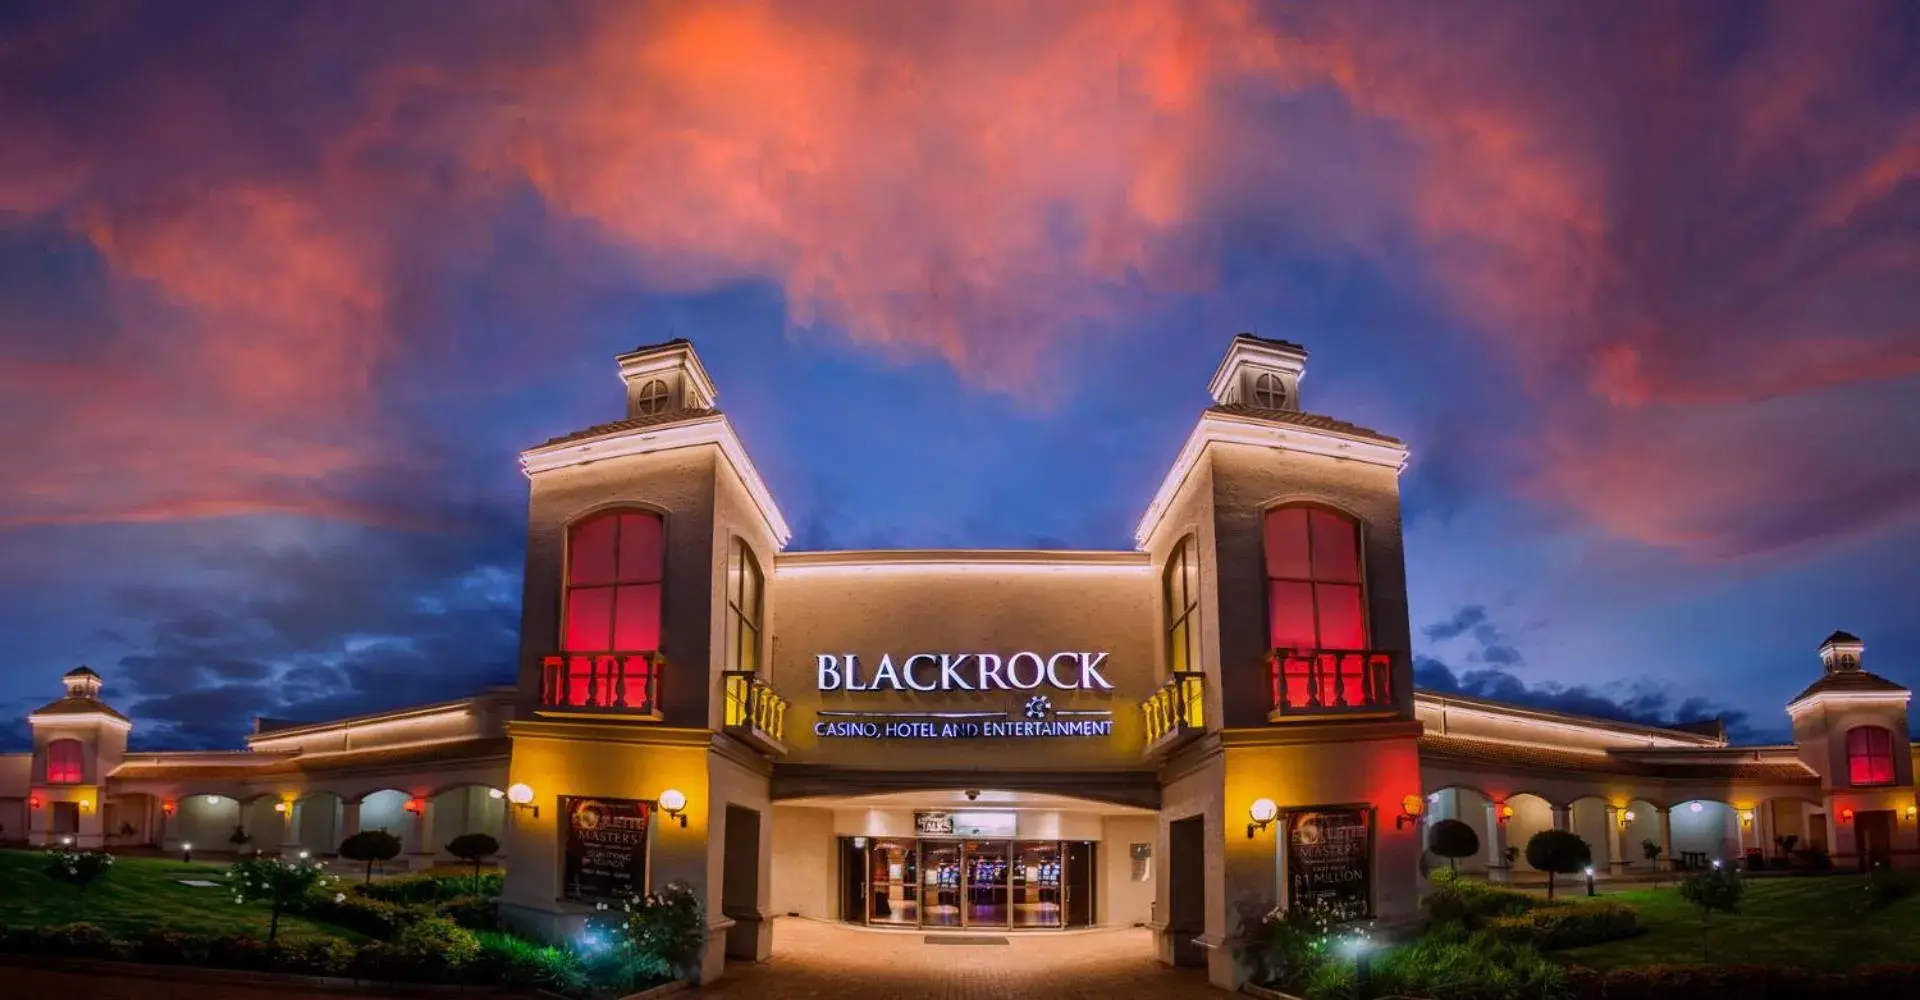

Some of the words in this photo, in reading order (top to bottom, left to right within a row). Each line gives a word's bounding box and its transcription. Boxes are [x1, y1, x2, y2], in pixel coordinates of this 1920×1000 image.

[816, 652, 1115, 691] BLACKROCK
[814, 722, 882, 738] CASINO,
[886, 722, 937, 737] HOTEL
[941, 722, 979, 738] AND
[983, 720, 1114, 737] ENTERTAINMENT
[579, 831, 638, 844] MASTERS
[1301, 843, 1359, 857] MASTERS
[1313, 870, 1362, 883] MILLION
